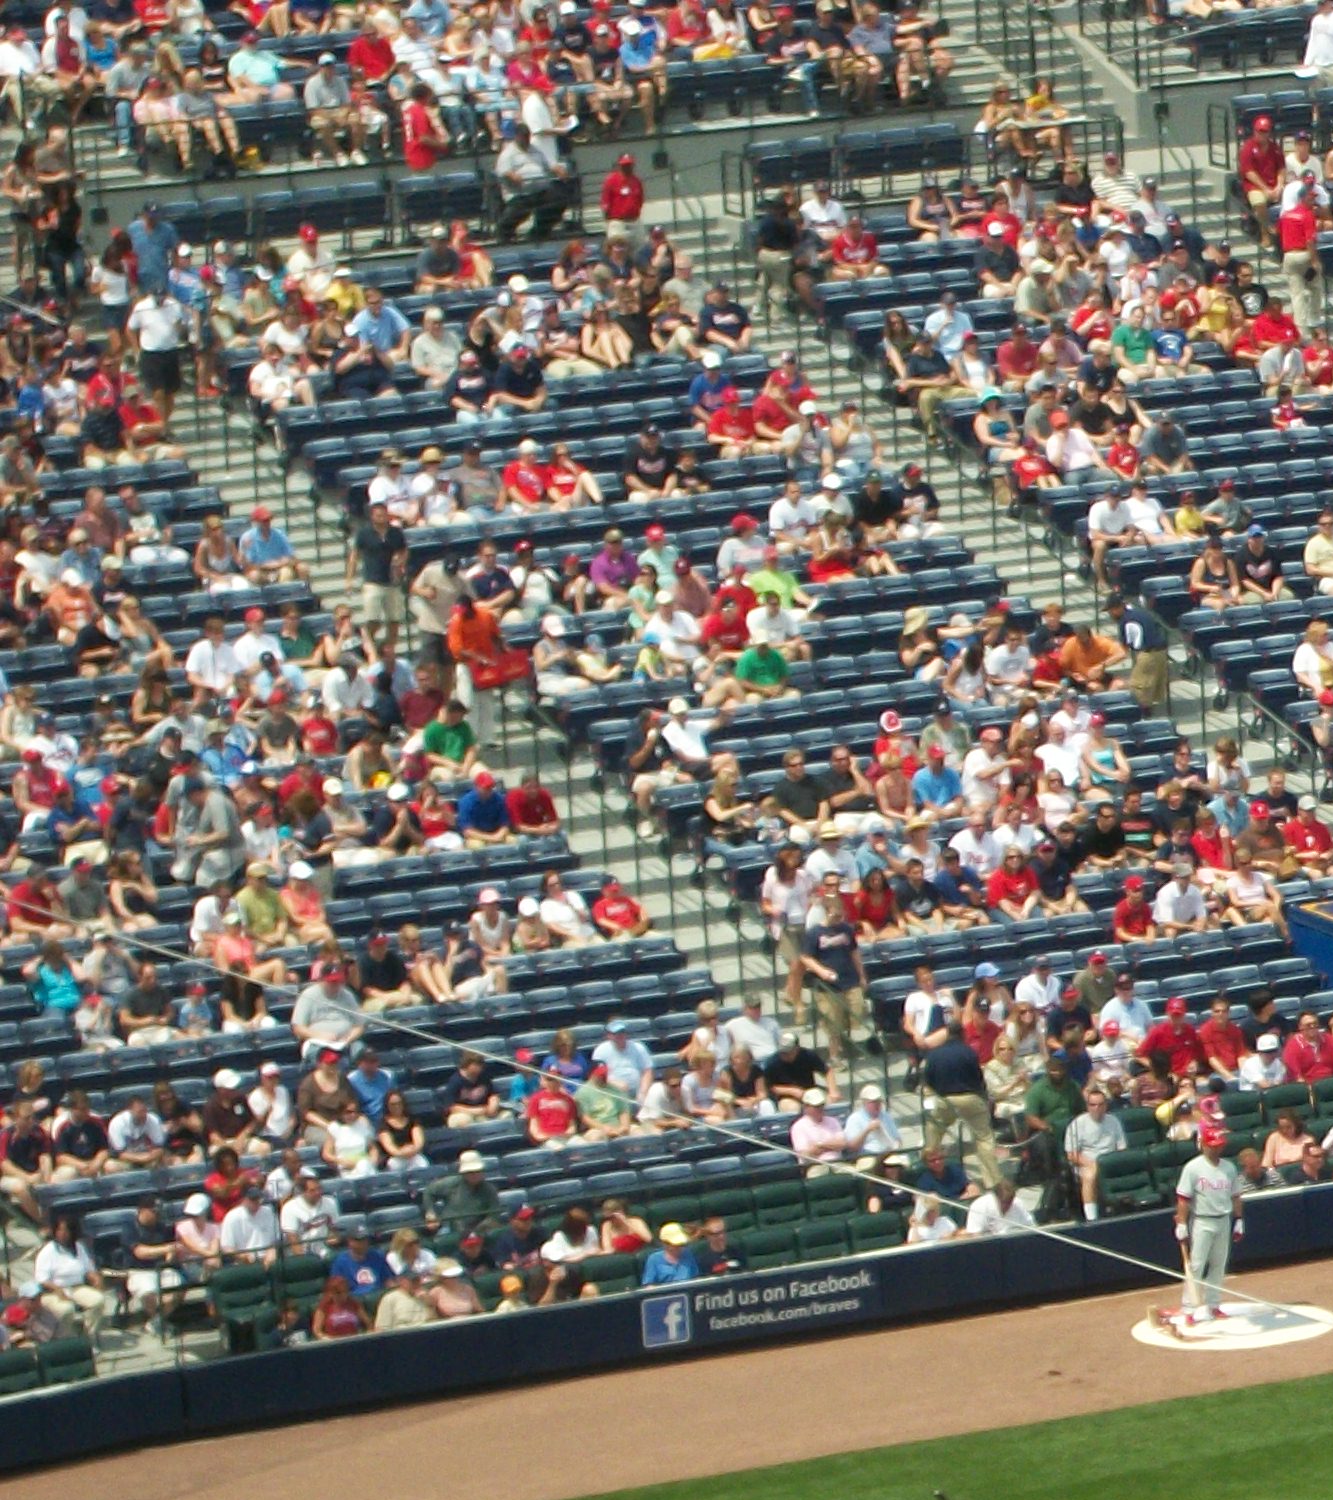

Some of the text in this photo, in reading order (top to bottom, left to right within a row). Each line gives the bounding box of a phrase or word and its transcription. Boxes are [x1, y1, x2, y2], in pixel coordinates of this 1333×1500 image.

[694, 1269, 871, 1312] Find us on Facebook
[709, 1297, 859, 1331] facebook.com/braves
